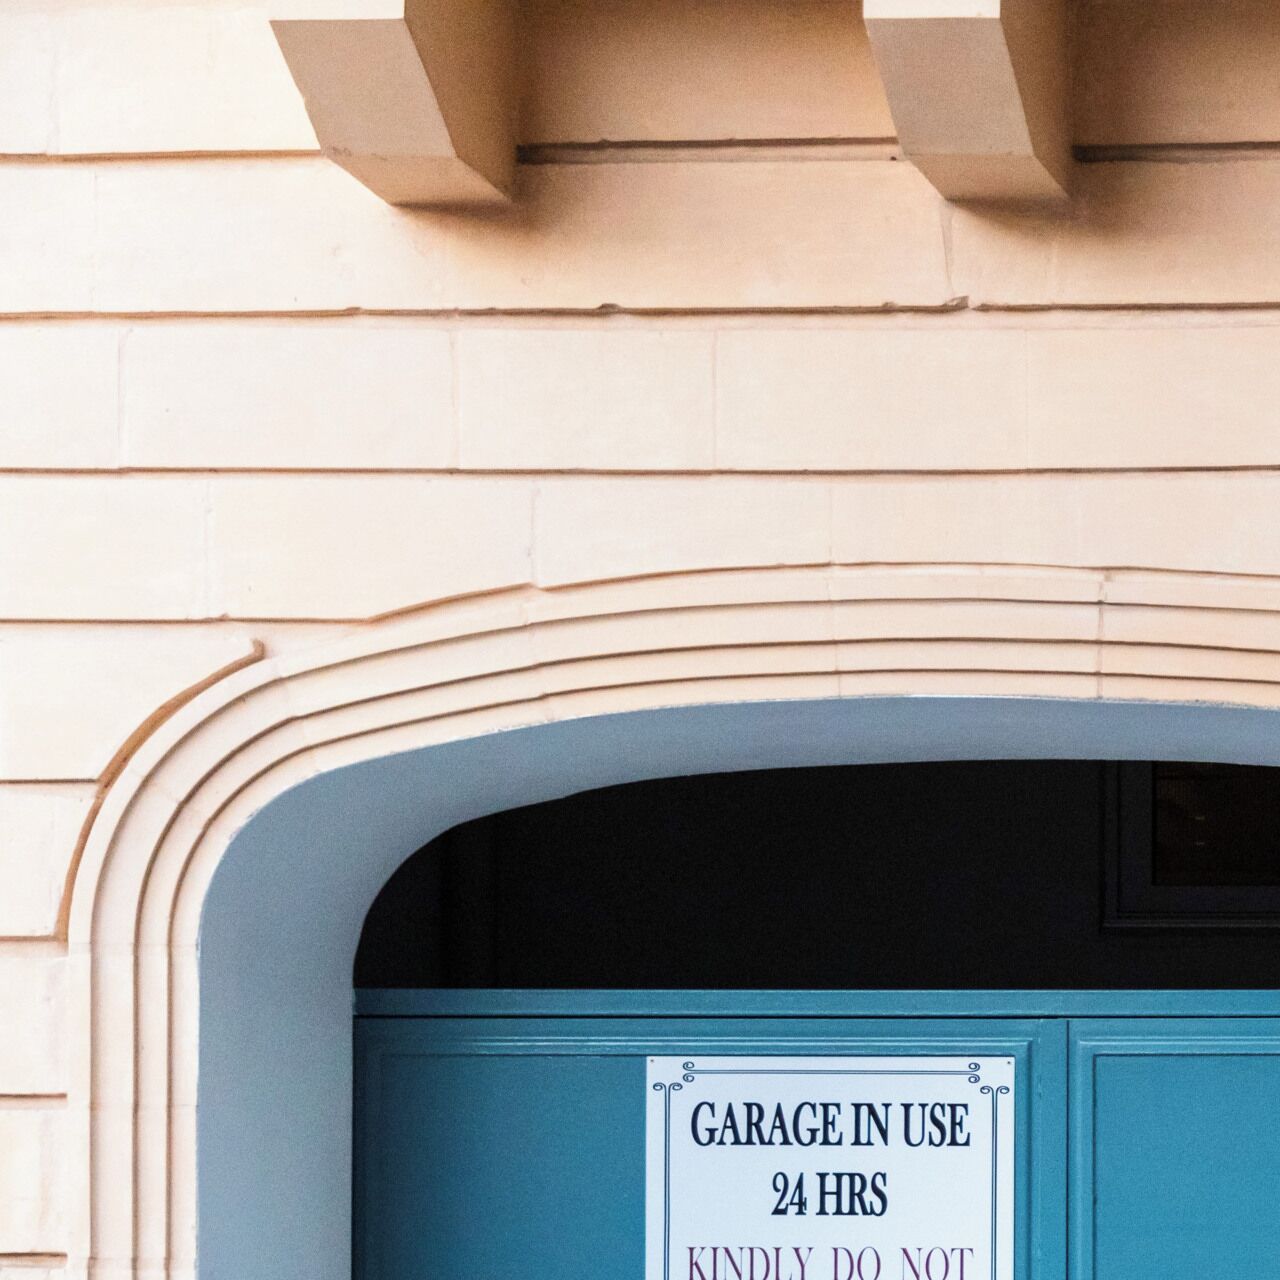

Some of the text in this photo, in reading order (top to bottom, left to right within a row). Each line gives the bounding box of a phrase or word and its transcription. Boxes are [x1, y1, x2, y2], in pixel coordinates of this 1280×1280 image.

[691, 1101, 970, 1147] GARAGE IN USE
[771, 1172, 888, 1217] 24 HRS
